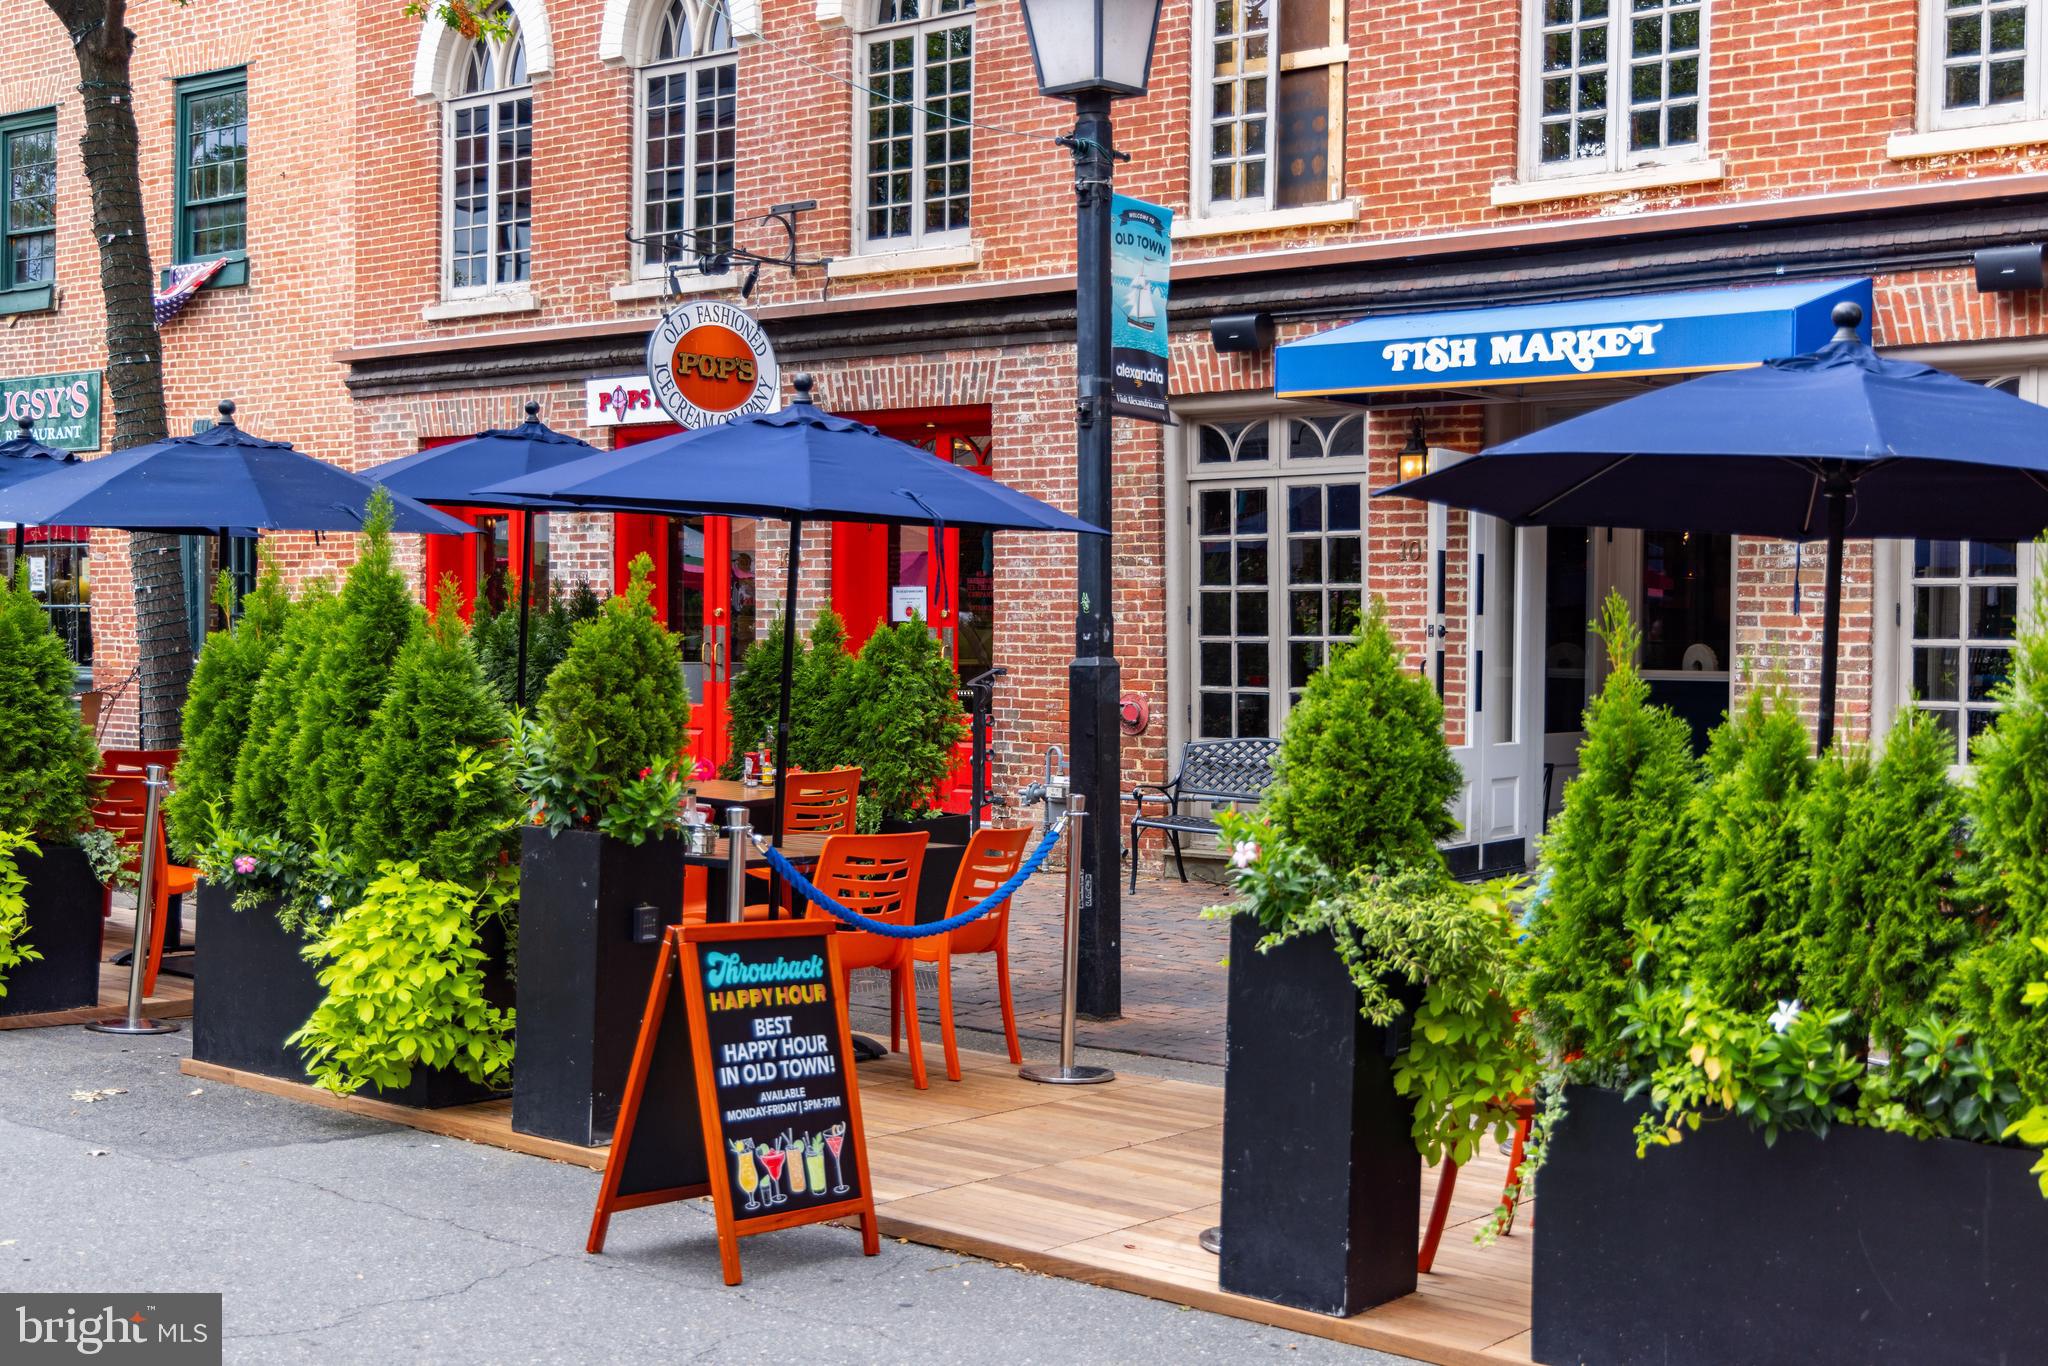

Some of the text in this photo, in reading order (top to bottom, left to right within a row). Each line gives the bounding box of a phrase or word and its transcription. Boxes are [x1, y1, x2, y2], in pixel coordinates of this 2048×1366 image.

[1115, 232, 1166, 257] OLD TOWN
[664, 304, 767, 357] OLD FASHIONED
[1382, 323, 1664, 372] FISH MARKET
[677, 352, 755, 382] POP'S
[1116, 363, 1164, 385] alexandria
[654, 362, 673, 396] ICE
[668, 391, 714, 428] CREAM
[5, 425, 82, 441] REAURANT
[1400, 540, 1422, 561] 10
[707, 951, 824, 988] Throwback
[709, 983, 827, 1011] HAPPY HOUR
[754, 1015, 793, 1037] BEST
[723, 1034, 828, 1063] HAPPY HOUR
[720, 1055, 836, 1086] IN OLD TOWN!
[726, 1102, 798, 1121] MONDAY-FRIDAY
[803, 1096, 841, 1111] 3PM-7PM
[760, 1087, 806, 1103] AVAILABLE
